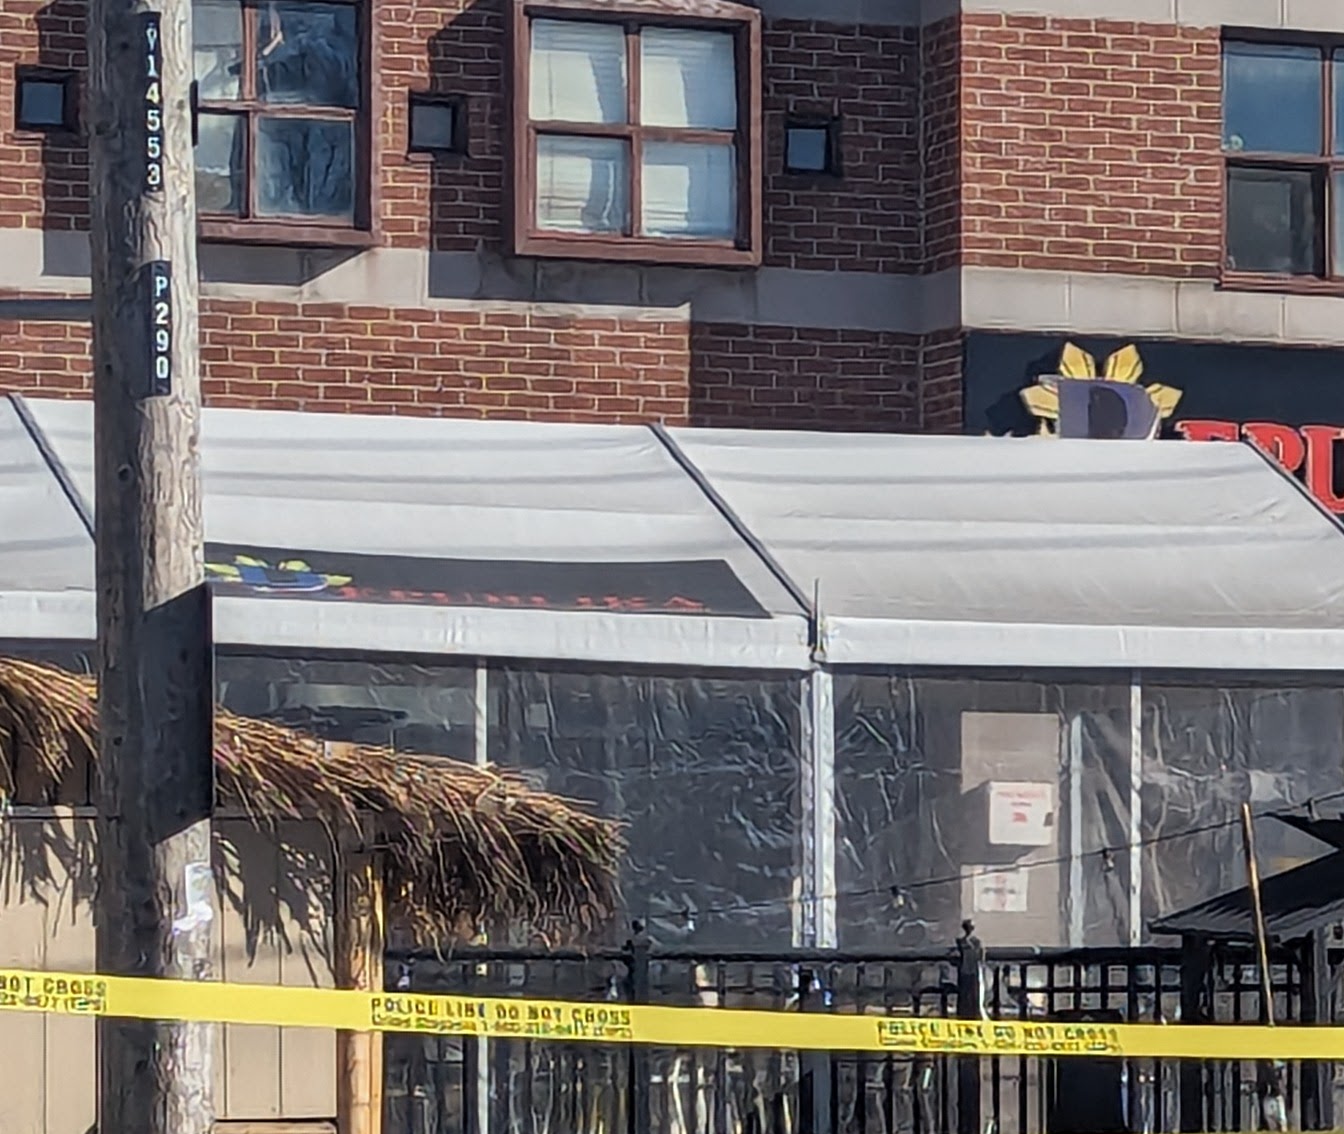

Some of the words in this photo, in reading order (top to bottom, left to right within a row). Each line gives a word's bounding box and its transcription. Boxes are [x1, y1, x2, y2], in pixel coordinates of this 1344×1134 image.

[154, 277, 171, 379] P290
[43, 977, 107, 998] CROSS
[371, 998, 438, 1017] POLICE
[495, 1003, 519, 1020] DO
[527, 1004, 562, 1021] NOT
[571, 1007, 631, 1026] CROSS
[877, 1020, 939, 1037] POLICE
